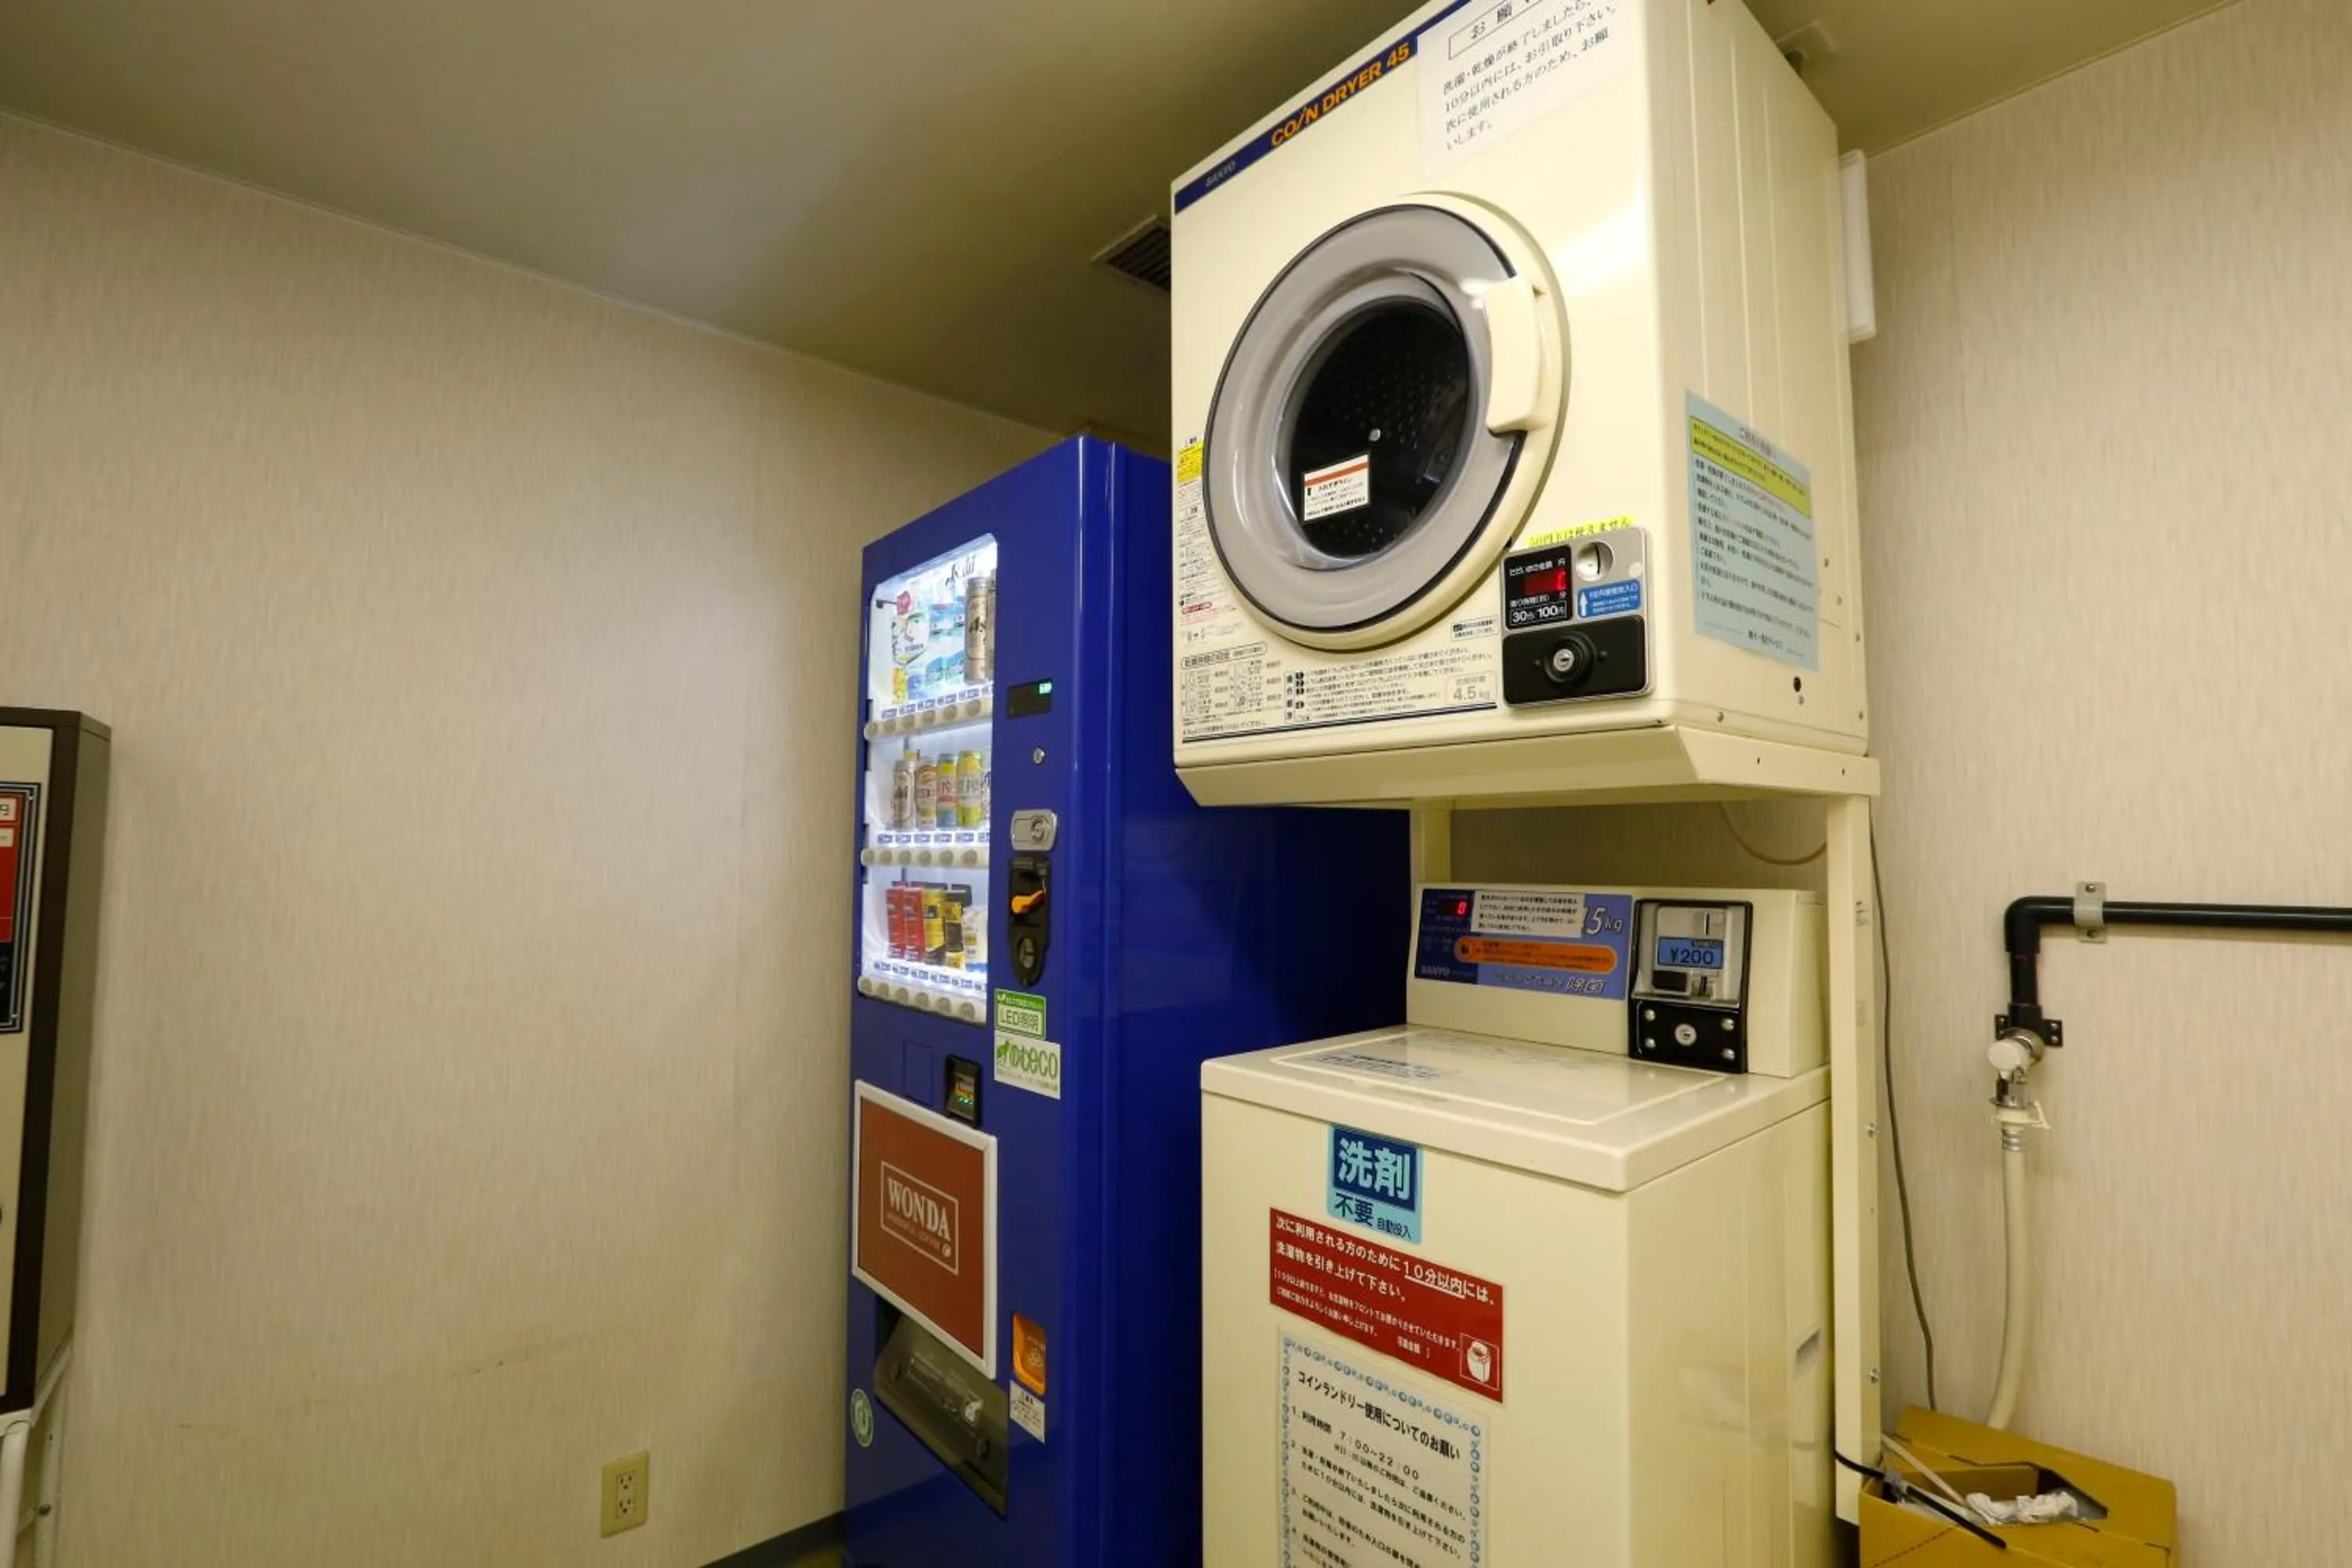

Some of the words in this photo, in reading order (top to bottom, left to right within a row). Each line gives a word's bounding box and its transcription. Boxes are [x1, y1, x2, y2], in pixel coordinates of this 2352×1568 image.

[1322, 62, 1382, 114] DRYER
[1386, 42, 1410, 68] 45
[1670, 946, 1715, 965] ¥200
[1338, 1137, 1410, 1200] 洗剤
[887, 1177, 951, 1242] WONDA
[1334, 1192, 1374, 1228] 不要
[1377, 1217, 1412, 1240] 自動投入
[1298, 1371, 1461, 1461] コインランドリー使用についてのお願い
